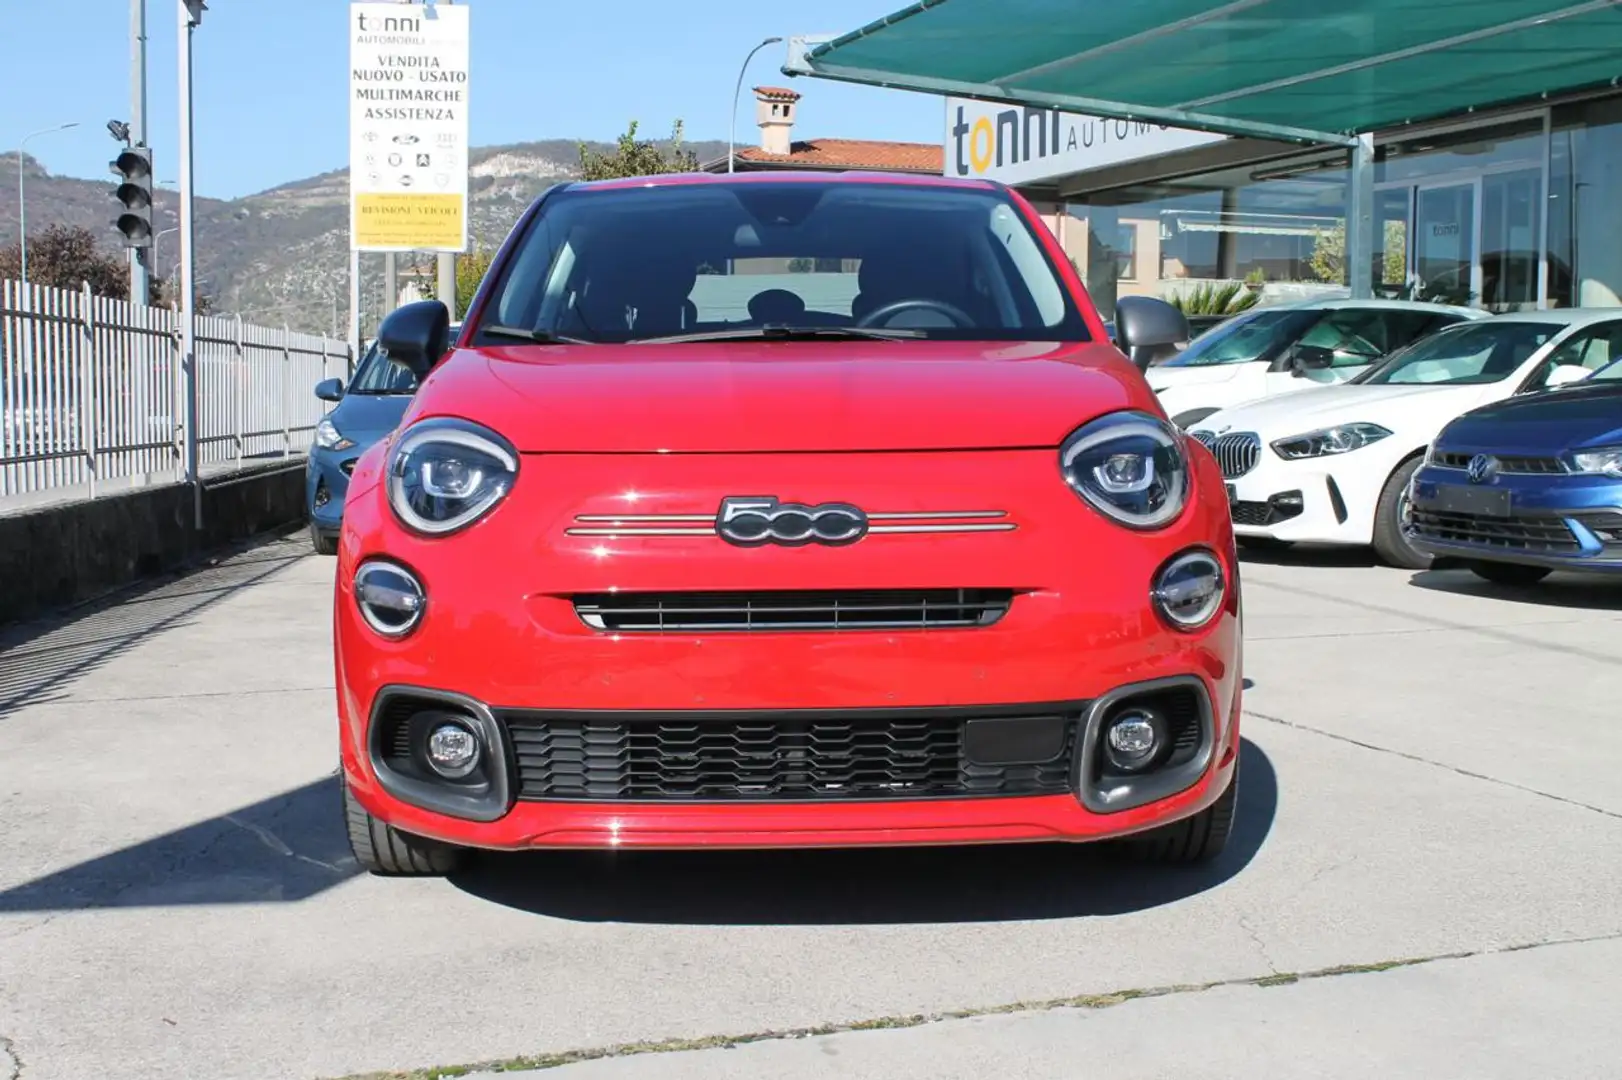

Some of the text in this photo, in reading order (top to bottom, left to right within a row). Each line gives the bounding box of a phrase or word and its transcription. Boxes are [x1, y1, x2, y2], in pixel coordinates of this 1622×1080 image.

[357, 12, 420, 32] tonni
[357, 35, 426, 45] AUTOMOBILI
[377, 54, 440, 68] VENDITA
[352, 69, 404, 82] NUOVO
[419, 70, 467, 83] USATO
[355, 87, 462, 102] MULTIMARCHE
[364, 107, 455, 121] ASSISTENZA
[952, 103, 1168, 176] tonni AUTOM
[1432, 222, 1460, 238] tonni
[718, 497, 867, 546] 500
